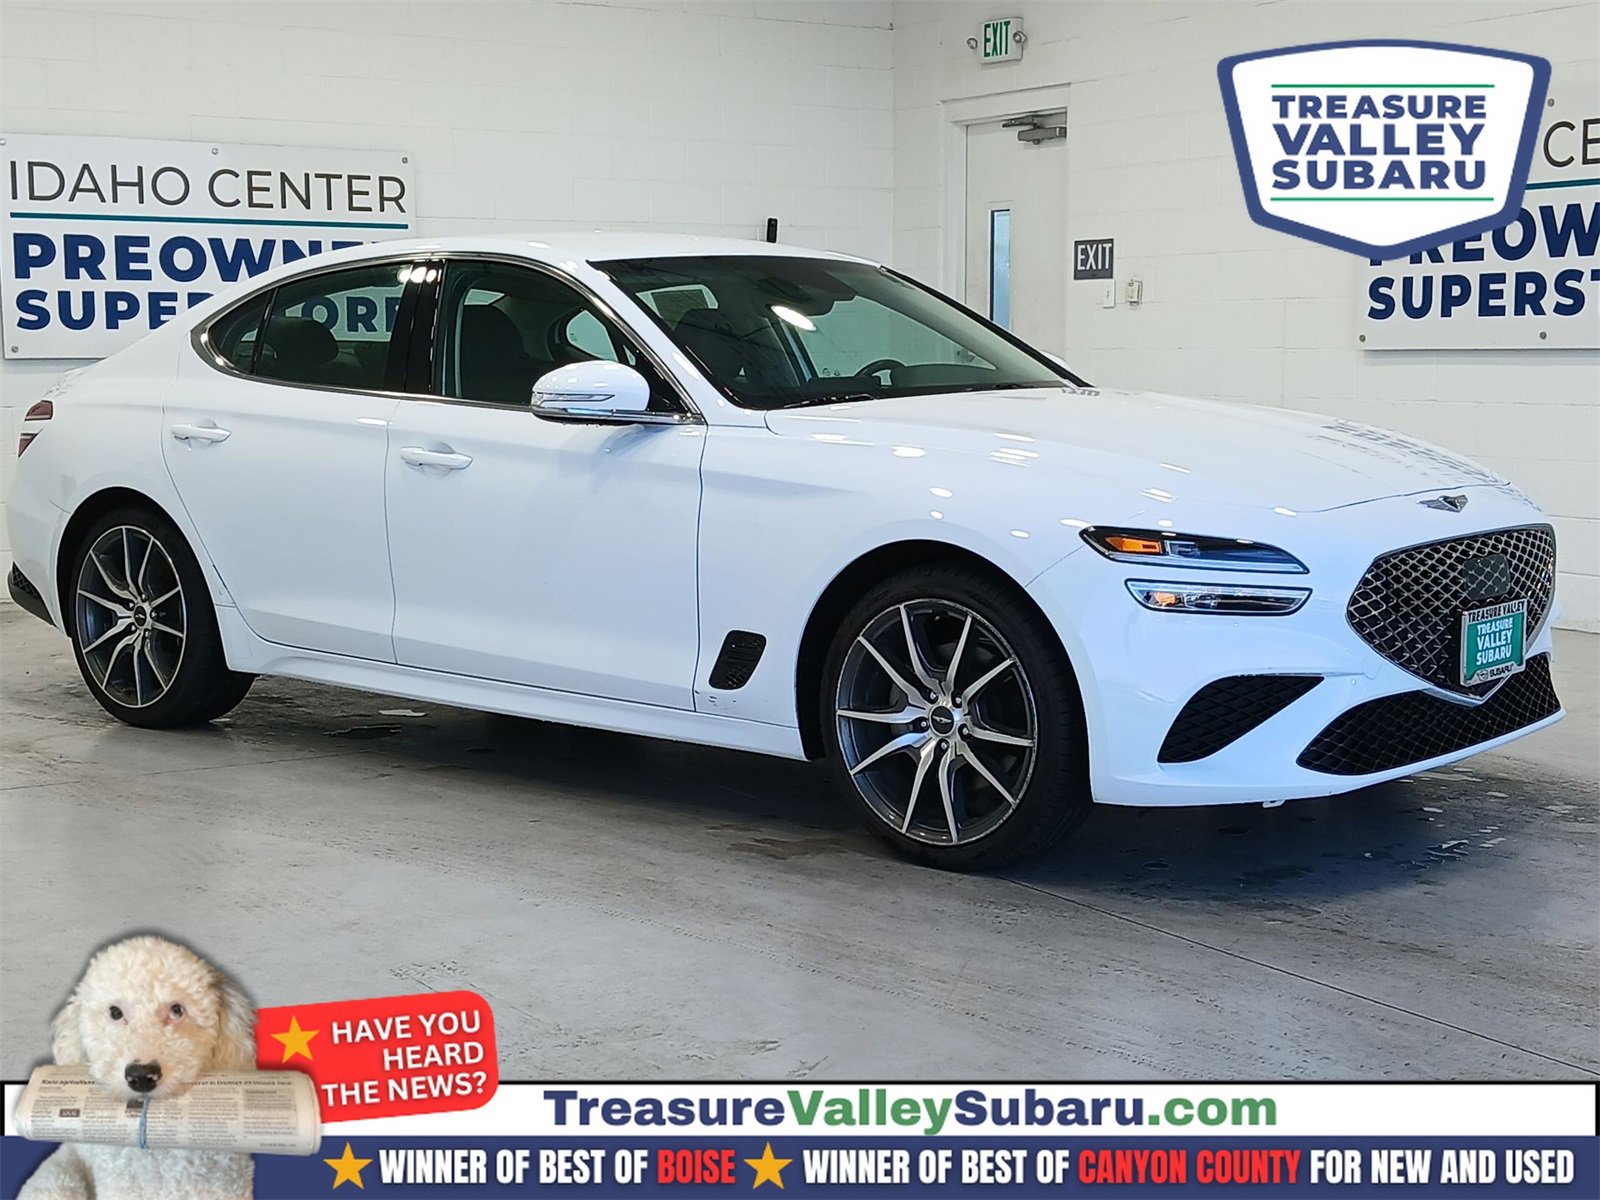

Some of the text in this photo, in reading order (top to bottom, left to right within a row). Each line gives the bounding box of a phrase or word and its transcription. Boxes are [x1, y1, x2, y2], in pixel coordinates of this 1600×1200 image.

[983, 20, 1012, 57] EXIT
[9, 160, 407, 213] IDAHO CENTER
[1077, 243, 1112, 271] EXIT
[1367, 268, 1600, 320] SUPERS
[1468, 600, 1525, 623] TREASURE VALLEY
[1477, 617, 1513, 636] TREASURE
[1477, 628, 1513, 650] VALLEY
[1476, 644, 1512, 665] SUBARU
[1489, 663, 1514, 677] SUBARU
